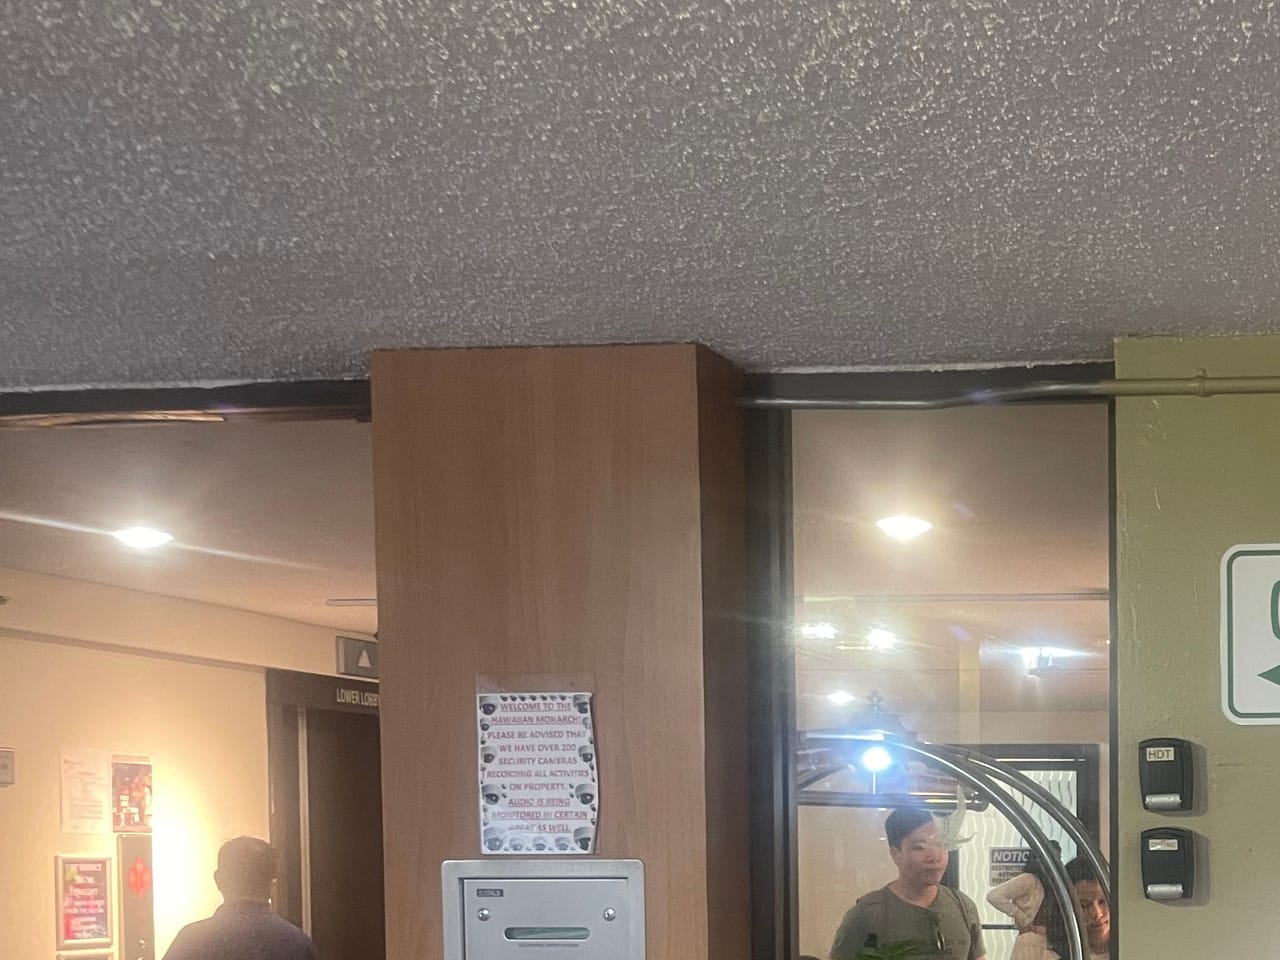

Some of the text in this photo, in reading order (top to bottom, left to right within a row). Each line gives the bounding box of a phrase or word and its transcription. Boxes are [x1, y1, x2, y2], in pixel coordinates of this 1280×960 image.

[337, 688, 359, 704] LOWER
[500, 703, 571, 711] WELCOME TO THE
[488, 731, 514, 739] PLEASE
[518, 731, 528, 739] BE
[530, 731, 564, 739] ADVISED
[500, 744, 511, 752] WE
[514, 744, 535, 752] HAVE
[538, 744, 559, 752] OVER
[1148, 750, 1172, 760] HDT
[499, 757, 577, 765] SECURITY CAMERAS
[487, 770, 589, 778] RECORDING ALL ACTIVITIES
[509, 783, 521, 791] ON
[509, 798, 533, 806] AUDIO
[554, 811, 587, 819] CERTAIN
[993, 851, 1030, 862] NOTIC
